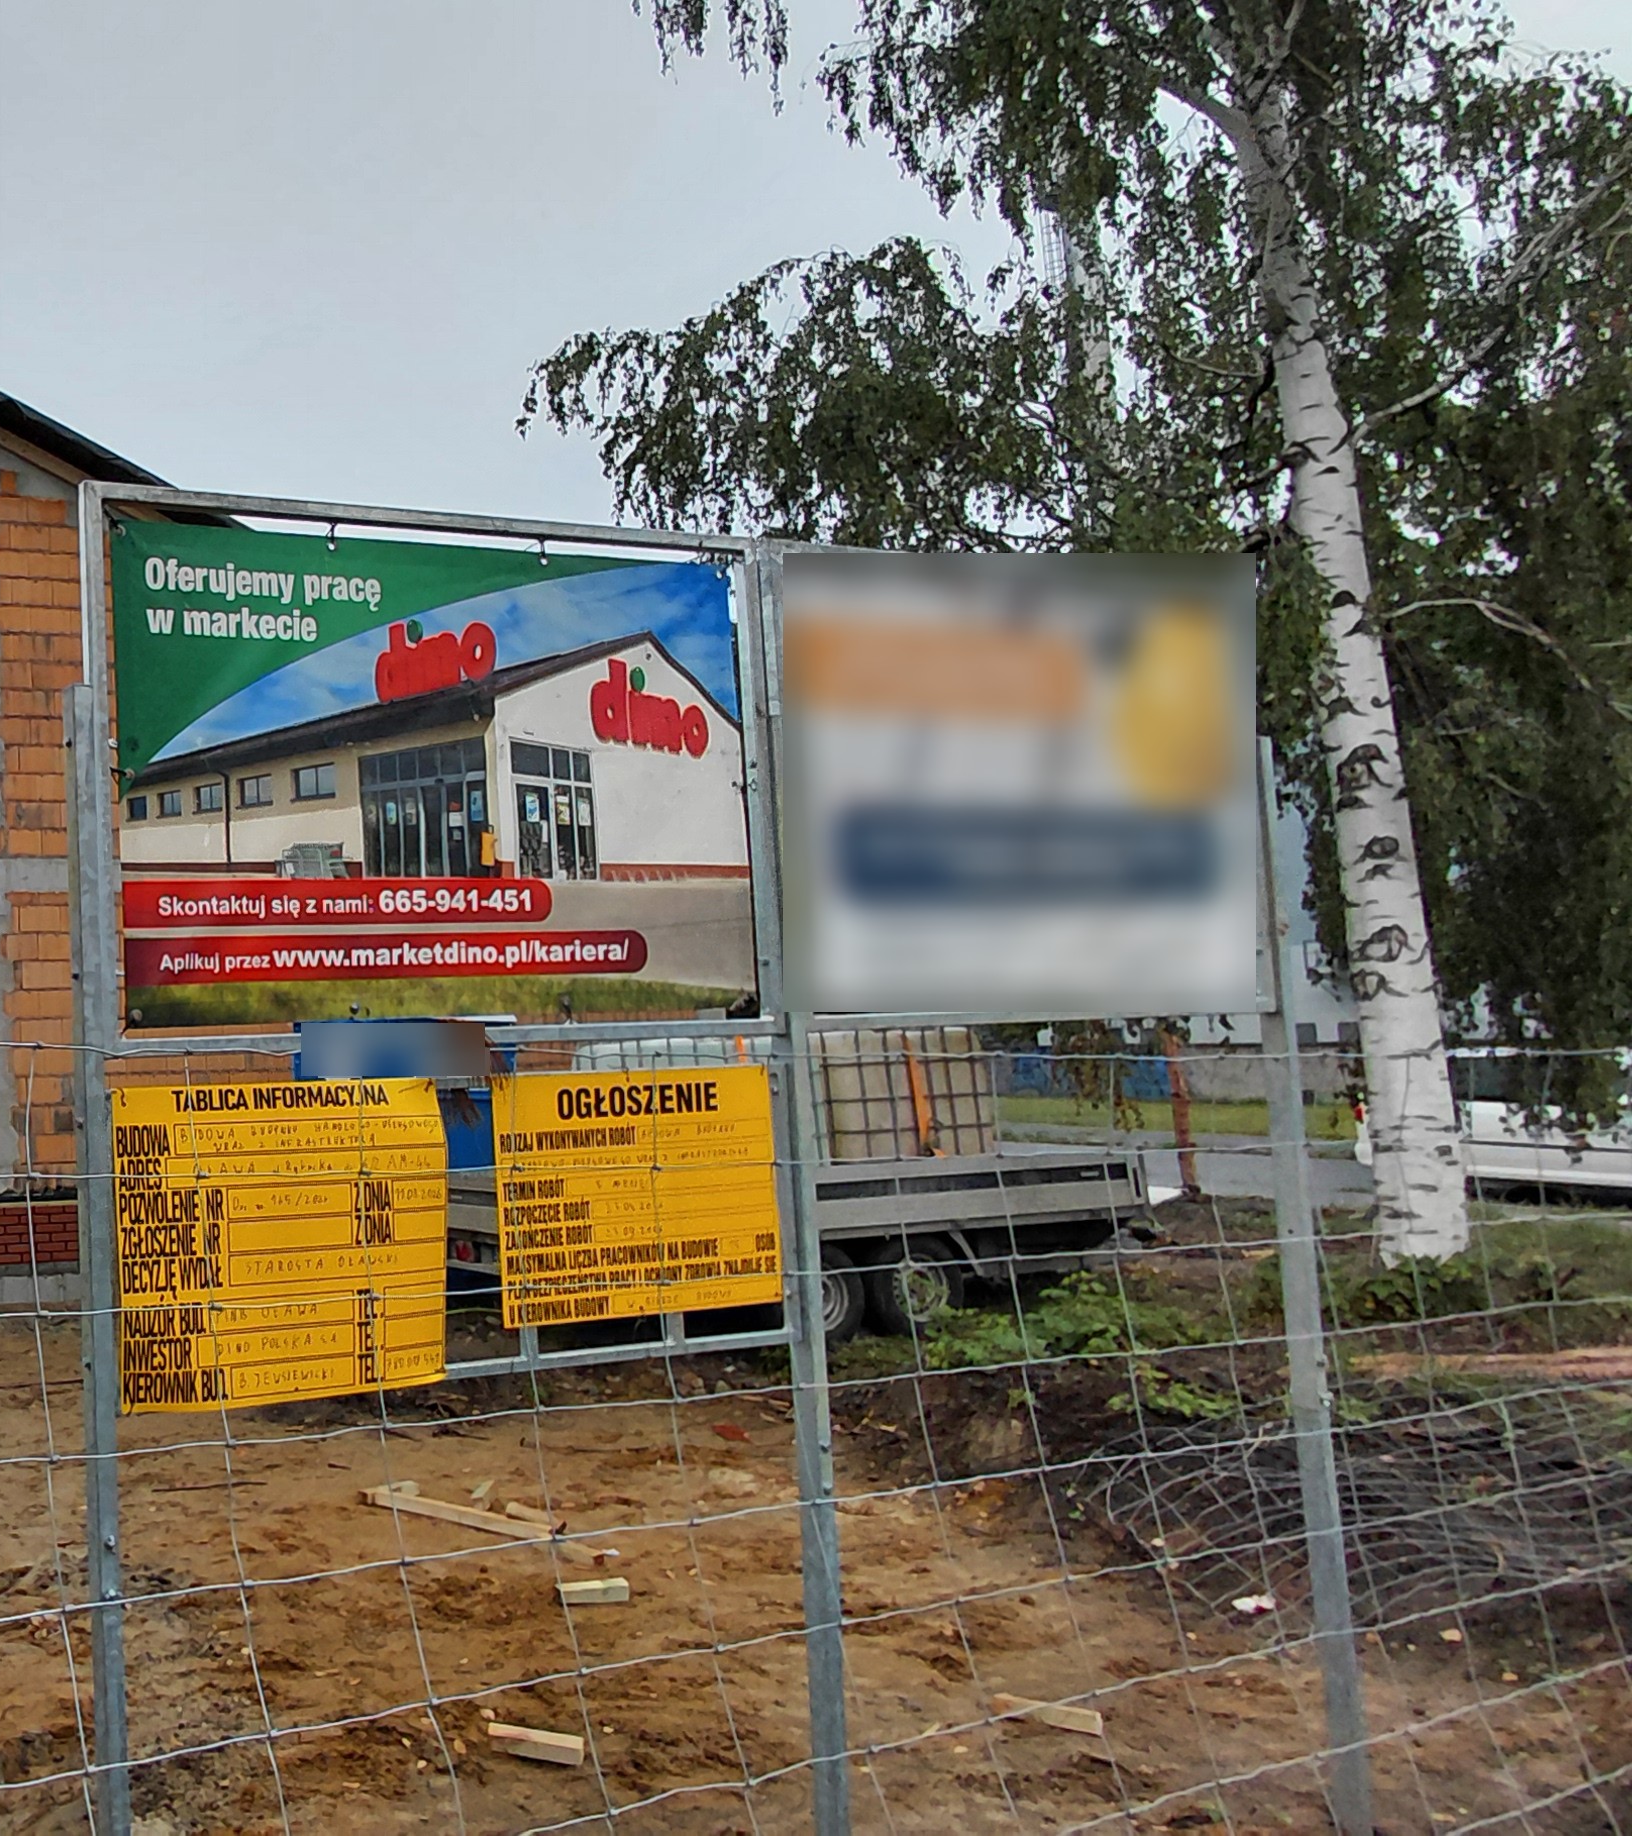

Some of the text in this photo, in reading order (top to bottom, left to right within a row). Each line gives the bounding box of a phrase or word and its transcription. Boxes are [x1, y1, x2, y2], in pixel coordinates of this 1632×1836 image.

[144, 557, 382, 611] Oferujemy pracę
[146, 607, 317, 642] w markecie
[375, 619, 497, 704] dino
[590, 658, 709, 759] dino
[158, 889, 532, 919] Skontaktuj się z nami: 665-941-451
[160, 937, 629, 974] Aplikuj przez www.marketdino.pl/kariera/
[171, 1084, 389, 1112] TABLICA INFORMACYJNA
[557, 1081, 718, 1120] OGŁOSZENIE
[115, 1124, 171, 1158] BUDOWA
[608, 1121, 636, 1147] ROBÓT
[118, 1158, 162, 1192] ADRES
[502, 1174, 565, 1202] TERMIN ROBÓT
[119, 1190, 200, 1226] POZWOLENIE
[205, 1188, 225, 1221] NR
[364, 1180, 391, 1212] DNIA
[563, 1195, 591, 1221] ROBÓT
[120, 1222, 222, 1260] ZGŁOSZENIE NR
[364, 1212, 392, 1245] DNIA
[566, 1220, 593, 1246] ROBÓT
[668, 1241, 680, 1261] NA
[122, 1255, 224, 1300] DECYZJĘ WYDAŁ
[124, 1294, 206, 1338] NADZÓR BUD.
[124, 1338, 192, 1371] INWESTOR
[123, 1370, 199, 1405] KIEROWNIK
